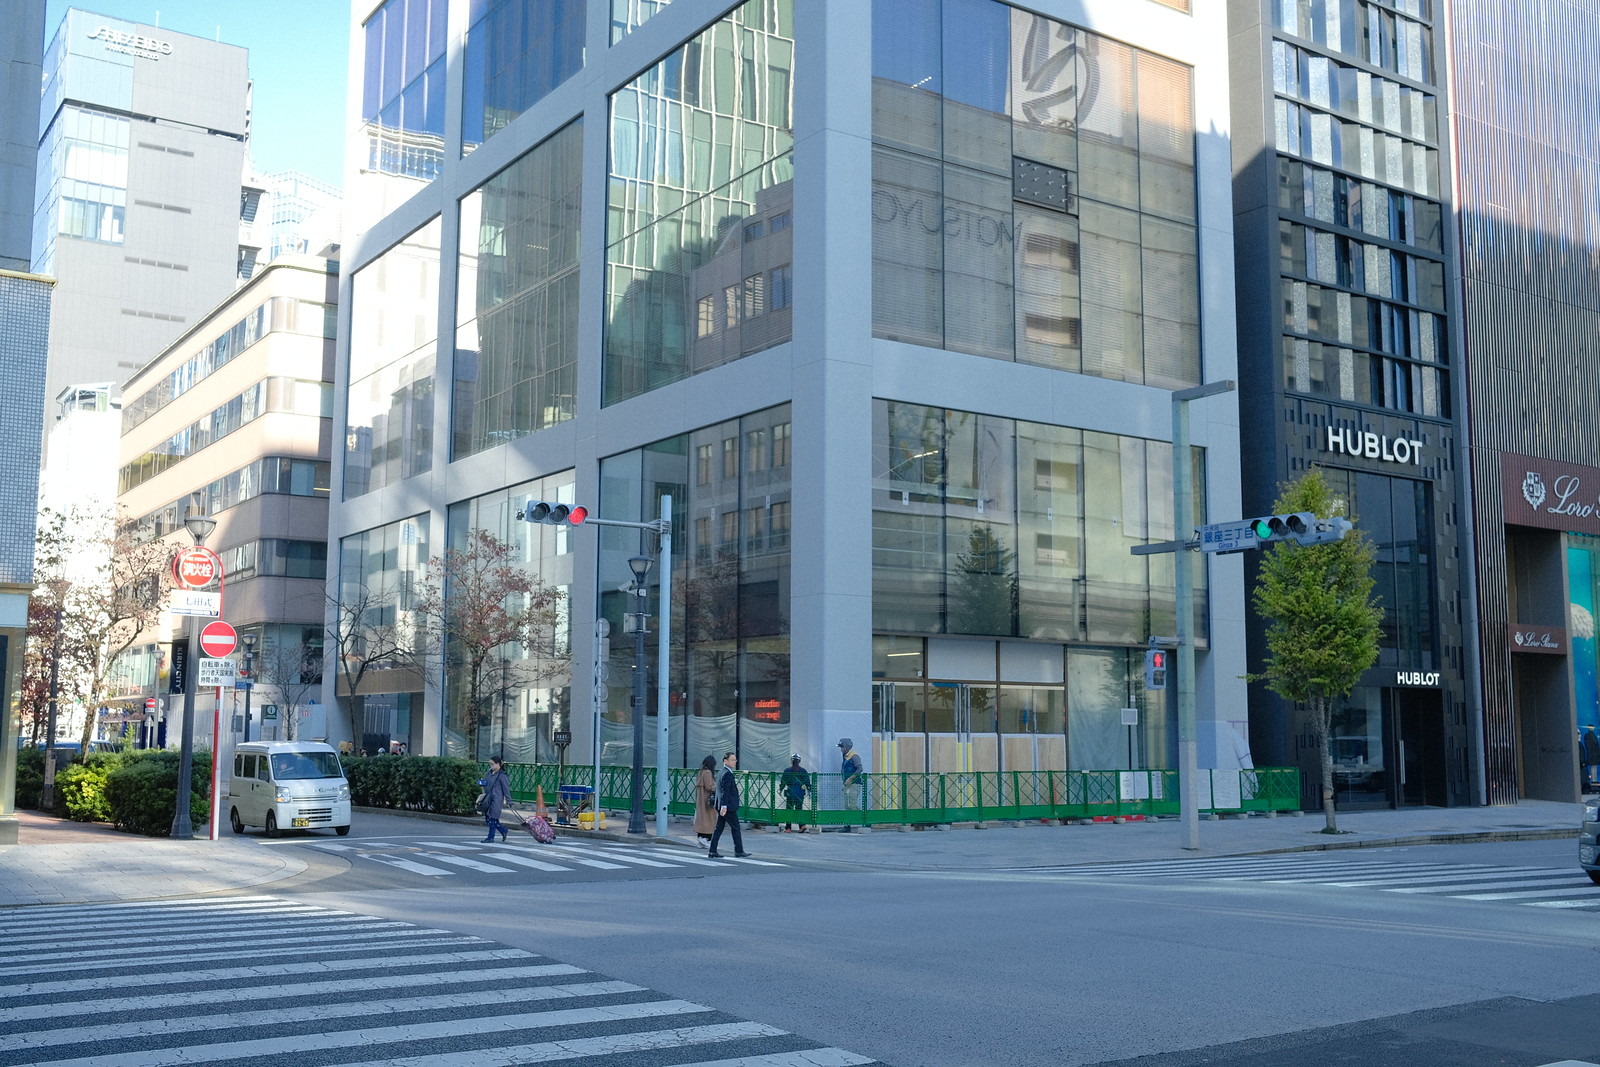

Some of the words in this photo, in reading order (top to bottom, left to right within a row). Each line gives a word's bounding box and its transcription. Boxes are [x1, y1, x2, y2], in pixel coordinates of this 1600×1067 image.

[87, 26, 173, 55] SHISEIDO
[1327, 426, 1423, 465] HUBLOT
[1547, 475, 1595, 518] Loro
[1204, 527, 1254, 543] 銀座三丁目
[183, 562, 212, 577] 消火栓
[1523, 631, 1540, 648] Loro
[201, 661, 234, 669] 自転車を除く
[1397, 671, 1440, 686] HUBLOT
